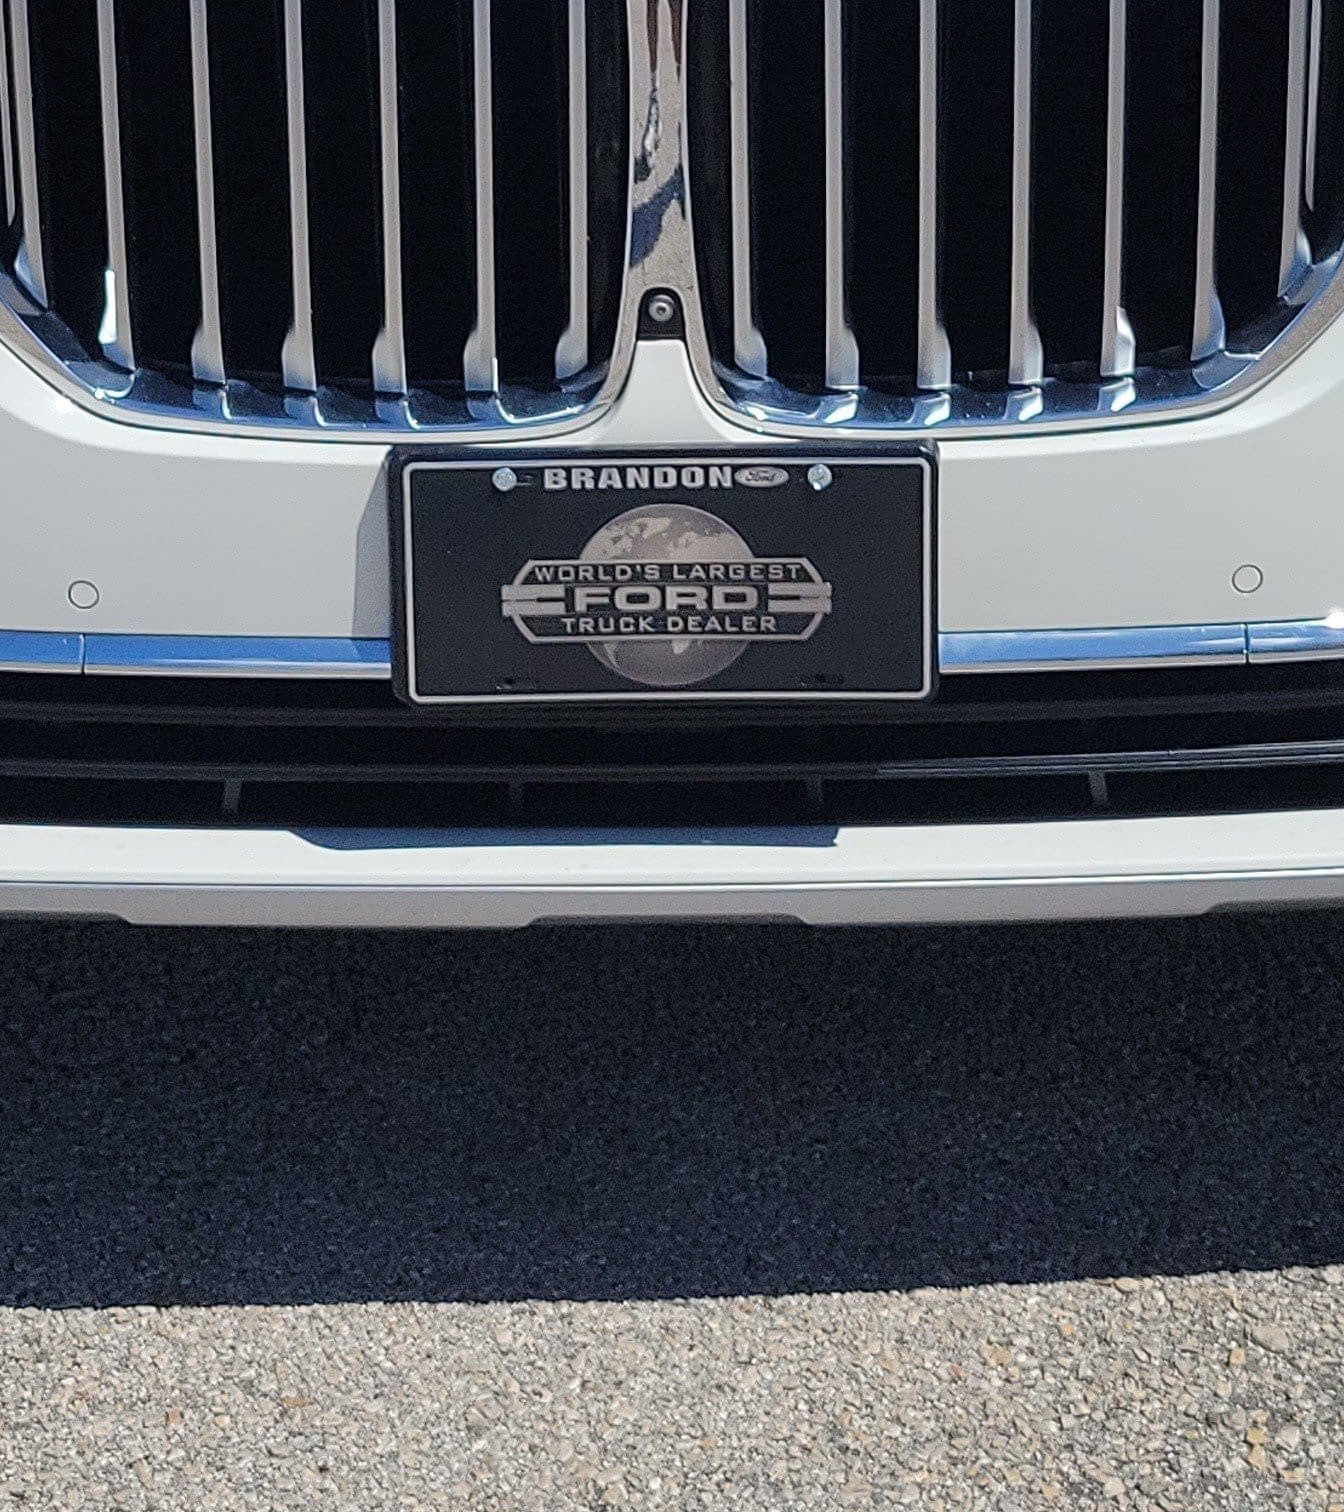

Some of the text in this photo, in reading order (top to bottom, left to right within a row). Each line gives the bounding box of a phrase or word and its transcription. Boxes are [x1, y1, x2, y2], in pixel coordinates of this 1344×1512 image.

[543, 465, 733, 489] BRANDON
[534, 563, 802, 582] WORLD'S LARGEST
[575, 586, 759, 612] FORD
[561, 615, 777, 633] TRUCK DEALER
